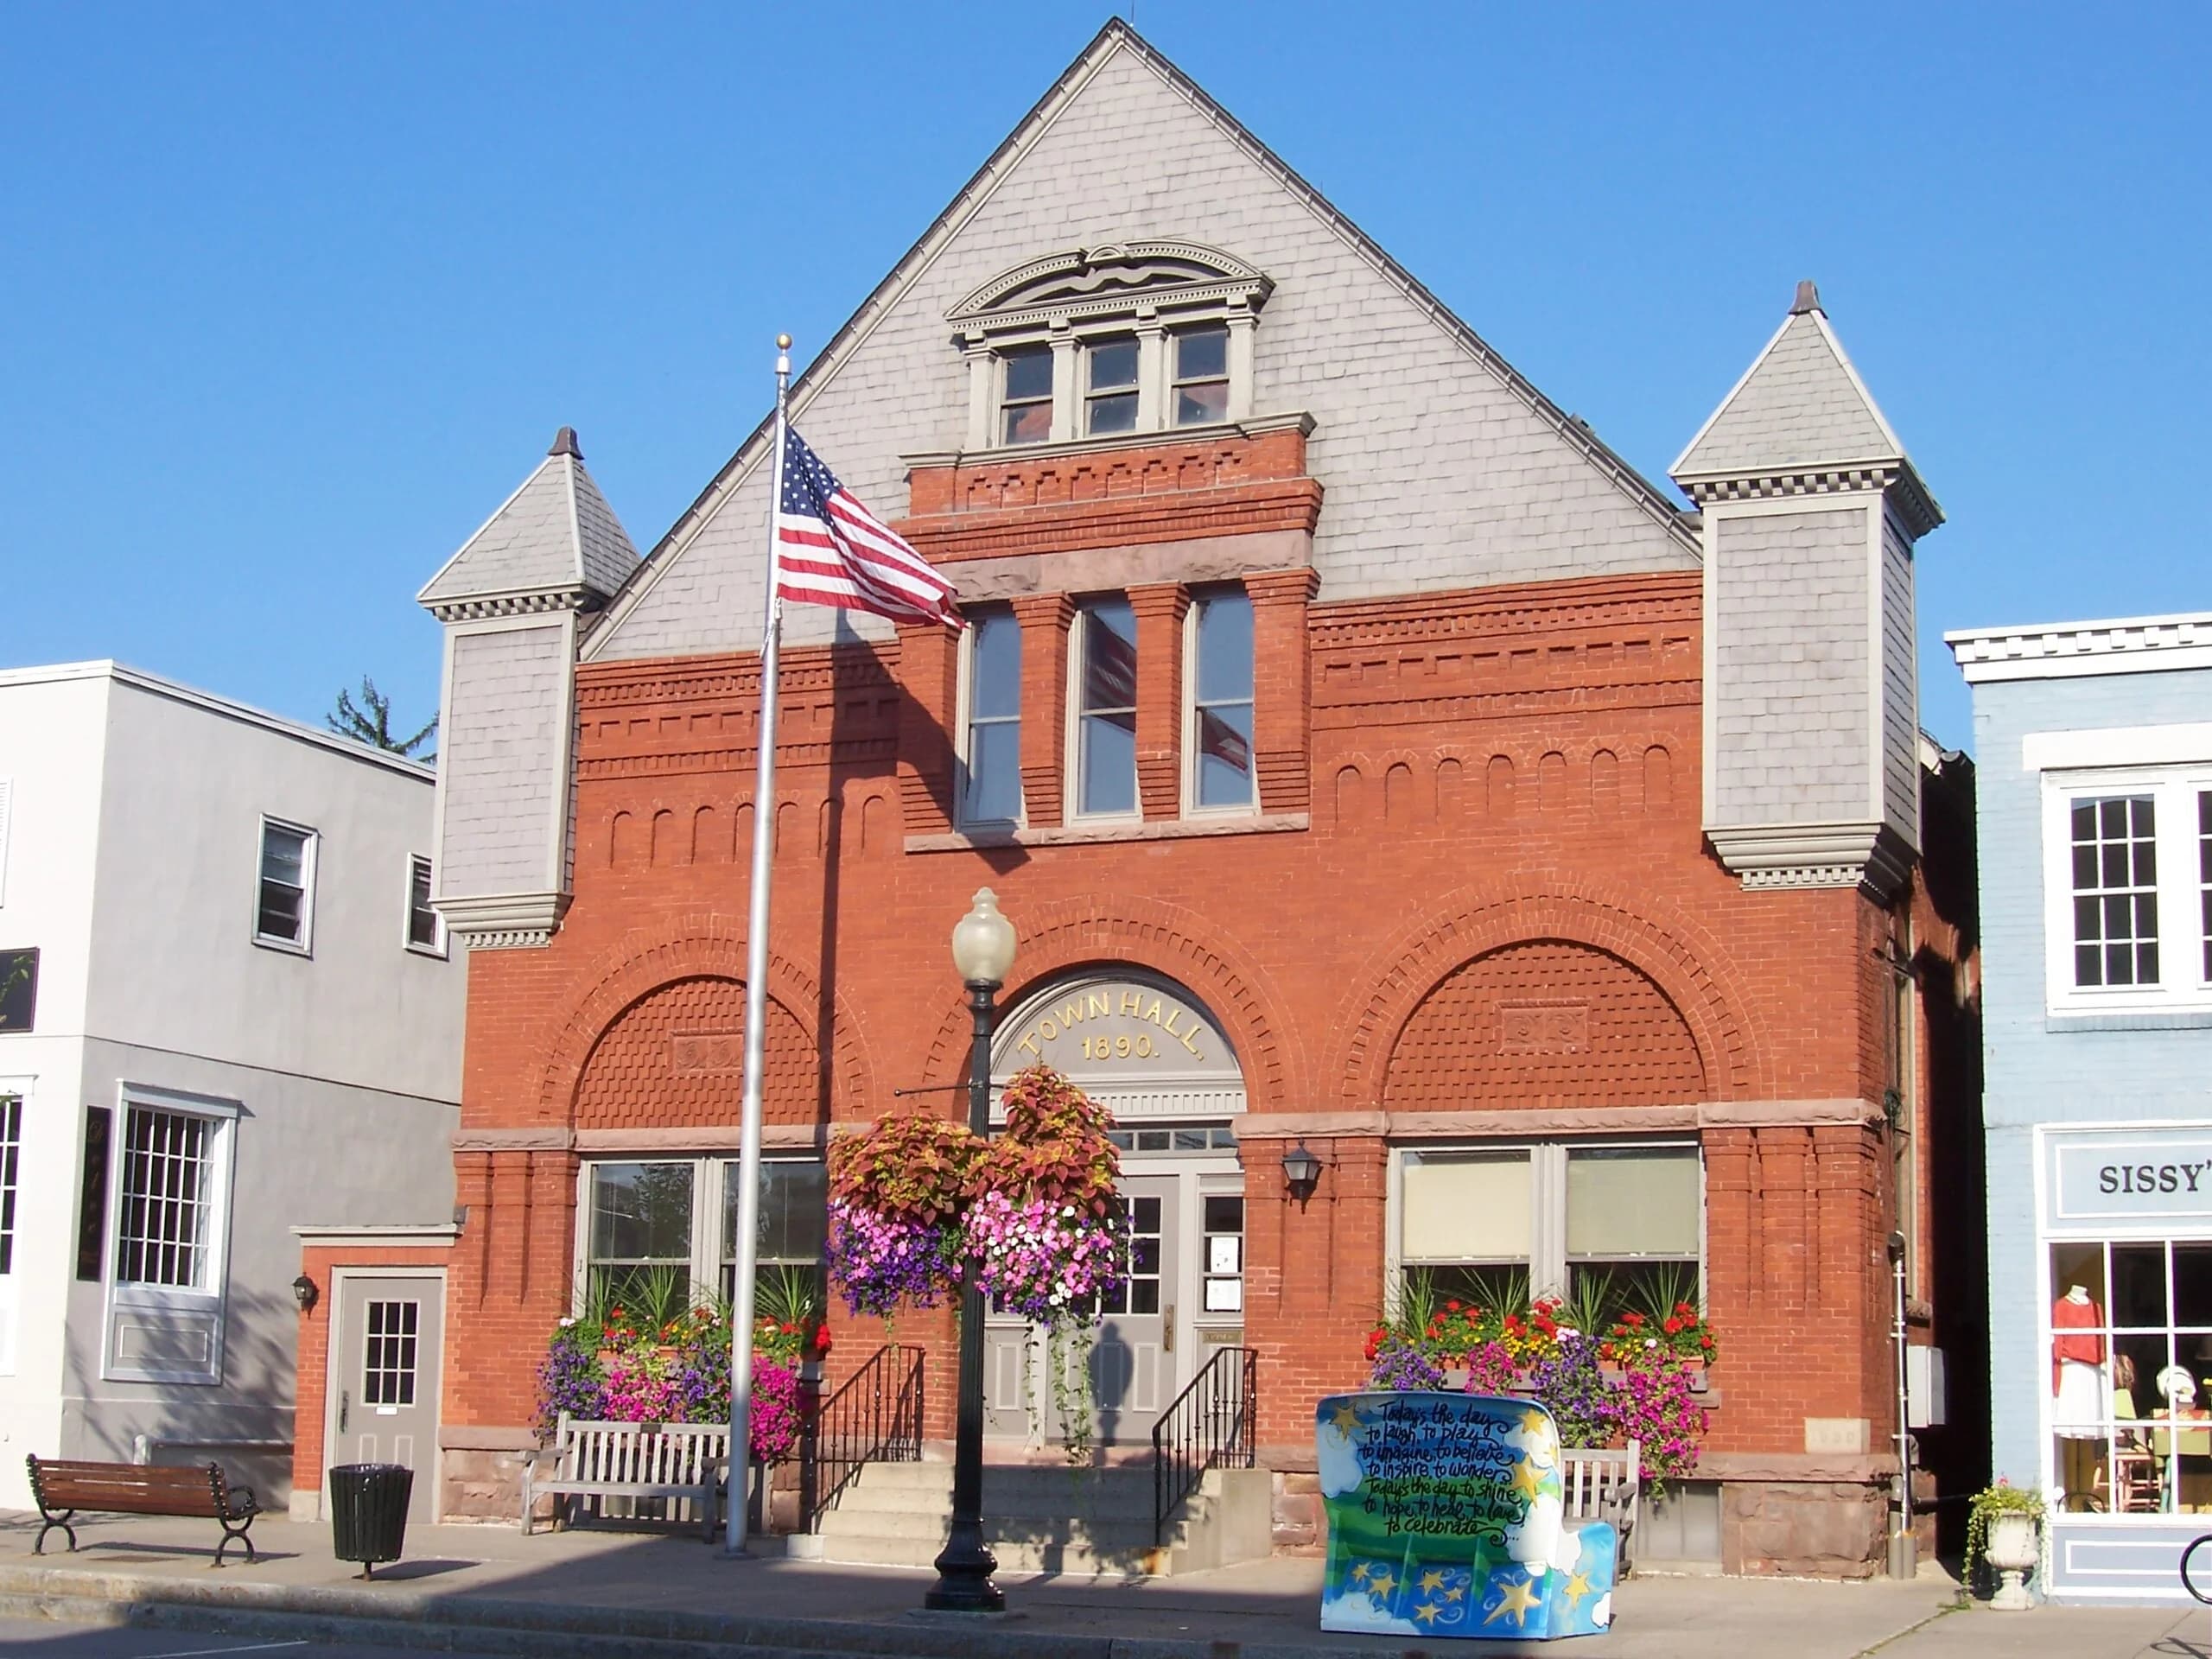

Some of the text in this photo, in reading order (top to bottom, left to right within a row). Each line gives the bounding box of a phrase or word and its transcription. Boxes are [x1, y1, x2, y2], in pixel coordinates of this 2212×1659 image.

[1018, 992, 1110, 1056] TOWN
[1082, 1036, 1160, 1059] 1890.
[1377, 1398, 1508, 1437] Today's the day
[1365, 1426, 1381, 1445] to
[1422, 1424, 1437, 1441] to
[1358, 1444, 1375, 1459] to
[1433, 1445, 1452, 1459] to
[1366, 1460, 1381, 1477] to
[1433, 1461, 1446, 1478] to
[1365, 1477, 1410, 1502] Today's
[1411, 1476, 1432, 1497] the
[1432, 1479, 1462, 1503] day
[1459, 1478, 1475, 1497] to
[1362, 1494, 1377, 1514] to
[1412, 1497, 1430, 1516] to
[1465, 1498, 1484, 1518] to
[1383, 1516, 1401, 1536] to
